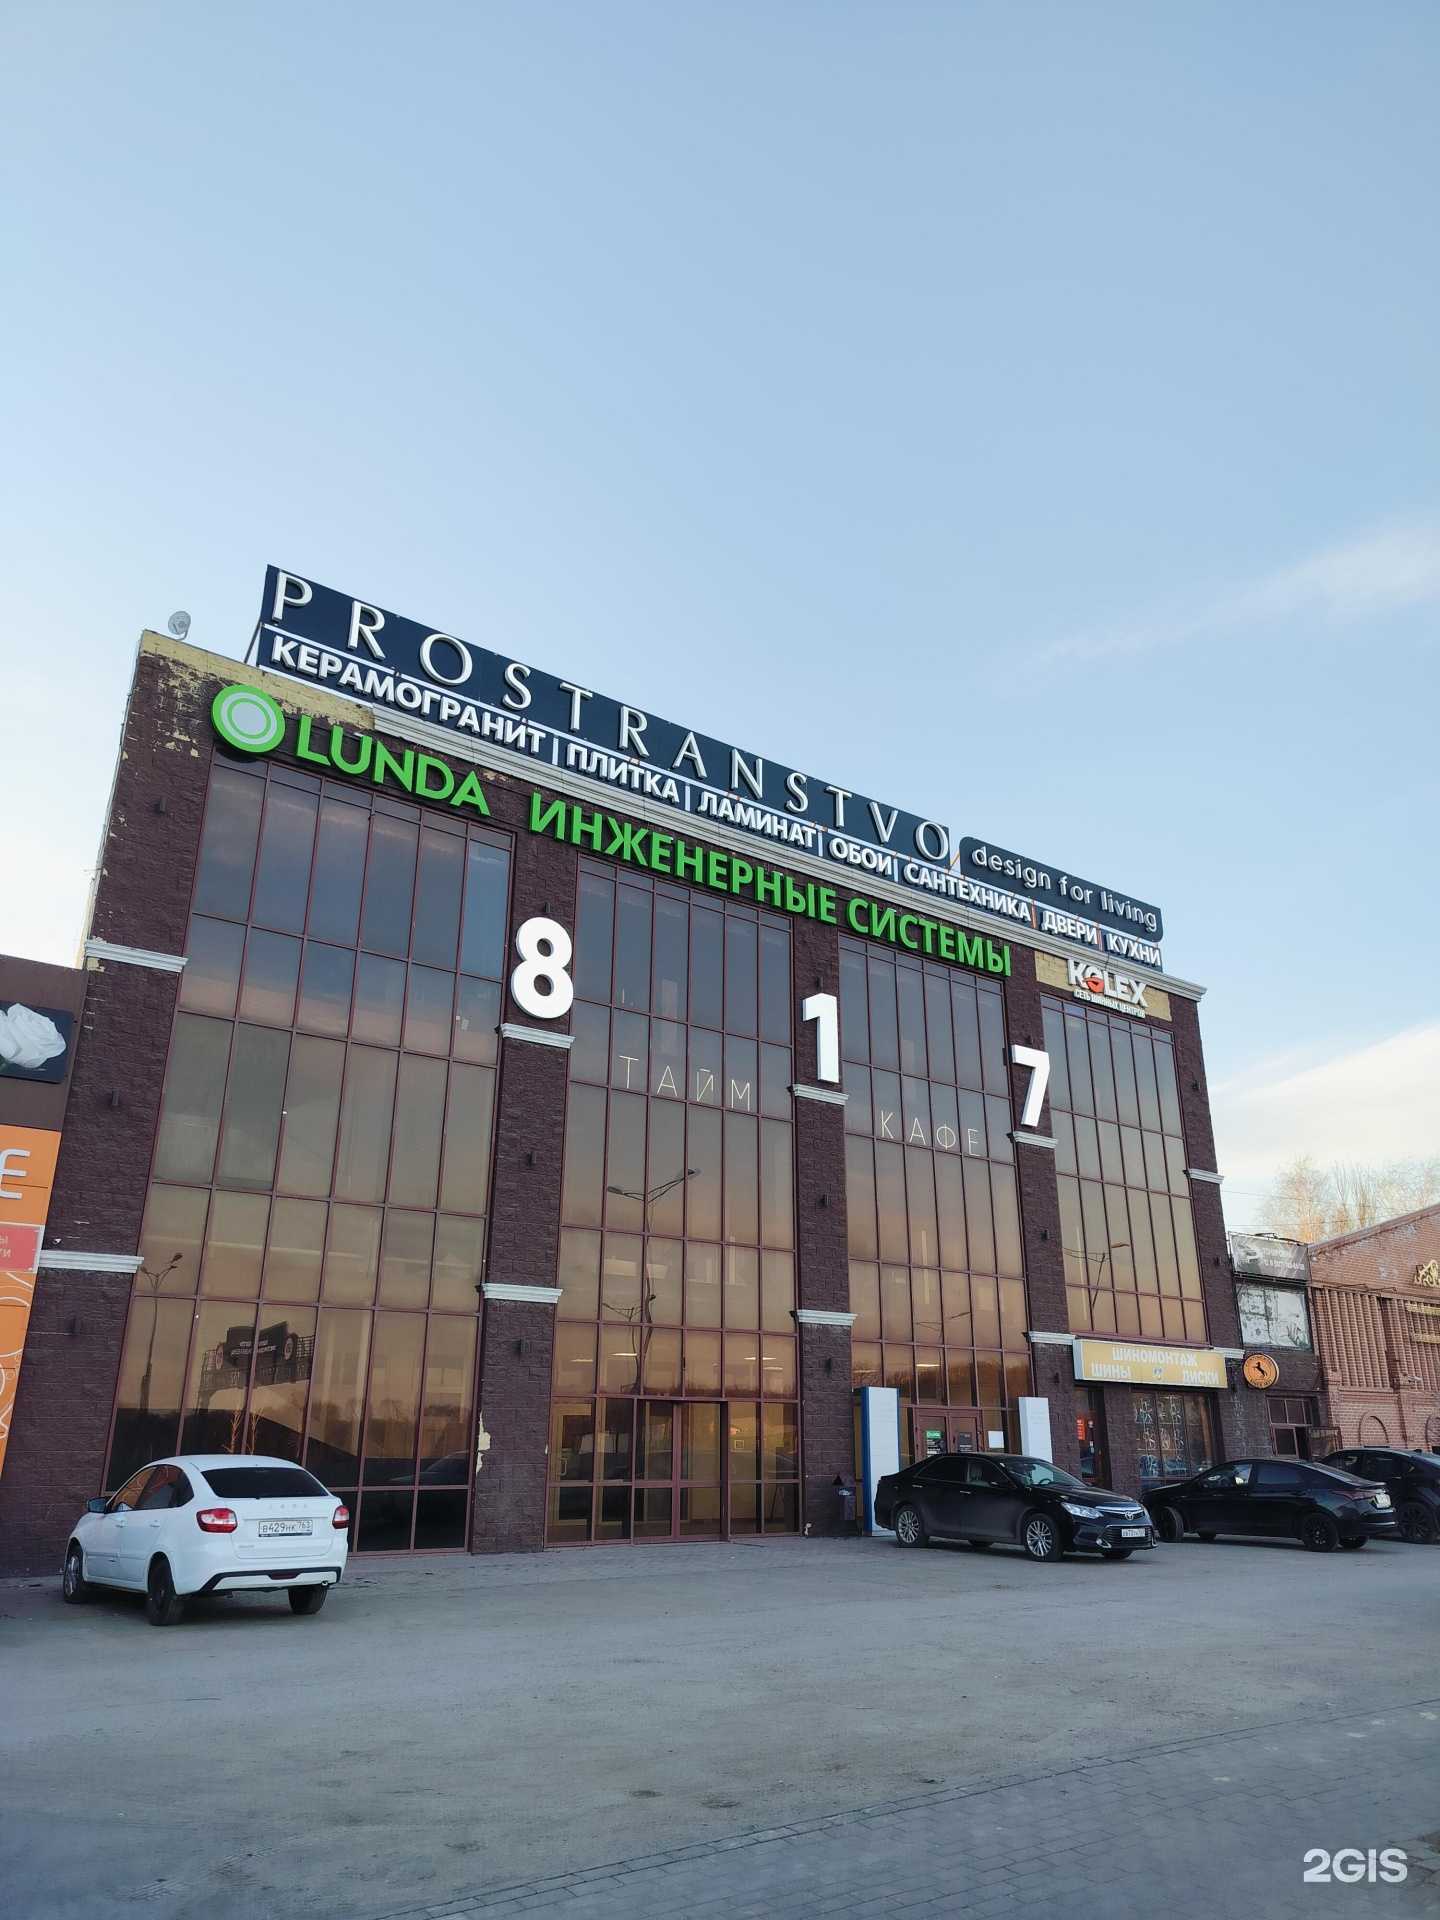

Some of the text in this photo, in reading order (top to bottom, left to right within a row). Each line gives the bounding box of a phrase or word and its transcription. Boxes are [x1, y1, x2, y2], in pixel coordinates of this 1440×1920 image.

[271, 571, 950, 861] PROSTRANSTVO
[271, 636, 1162, 967] КЕРАМОГРАНИТ ПЛИТКА ЛАМИНАТ ОБОИ САНТЕХНИКА ДВЕРИ КУХНИ
[296, 713, 492, 818] LUNDA
[529, 791, 1012, 978] ИНЖЕНЕРНЫЕ СИСТЕМЫ
[971, 845, 1158, 932] design for living
[510, 916, 574, 1020] 8
[802, 992, 840, 1083] 1
[619, 1055, 752, 1113] ТАЙМ
[1011, 1044, 1051, 1128] 7
[880, 1111, 981, 1157] КАФЕ
[1091, 1362, 1220, 1385] ШИНЫ ДИСКИ
[1112, 1347, 1198, 1367] ШИНОМОНТАЖ
